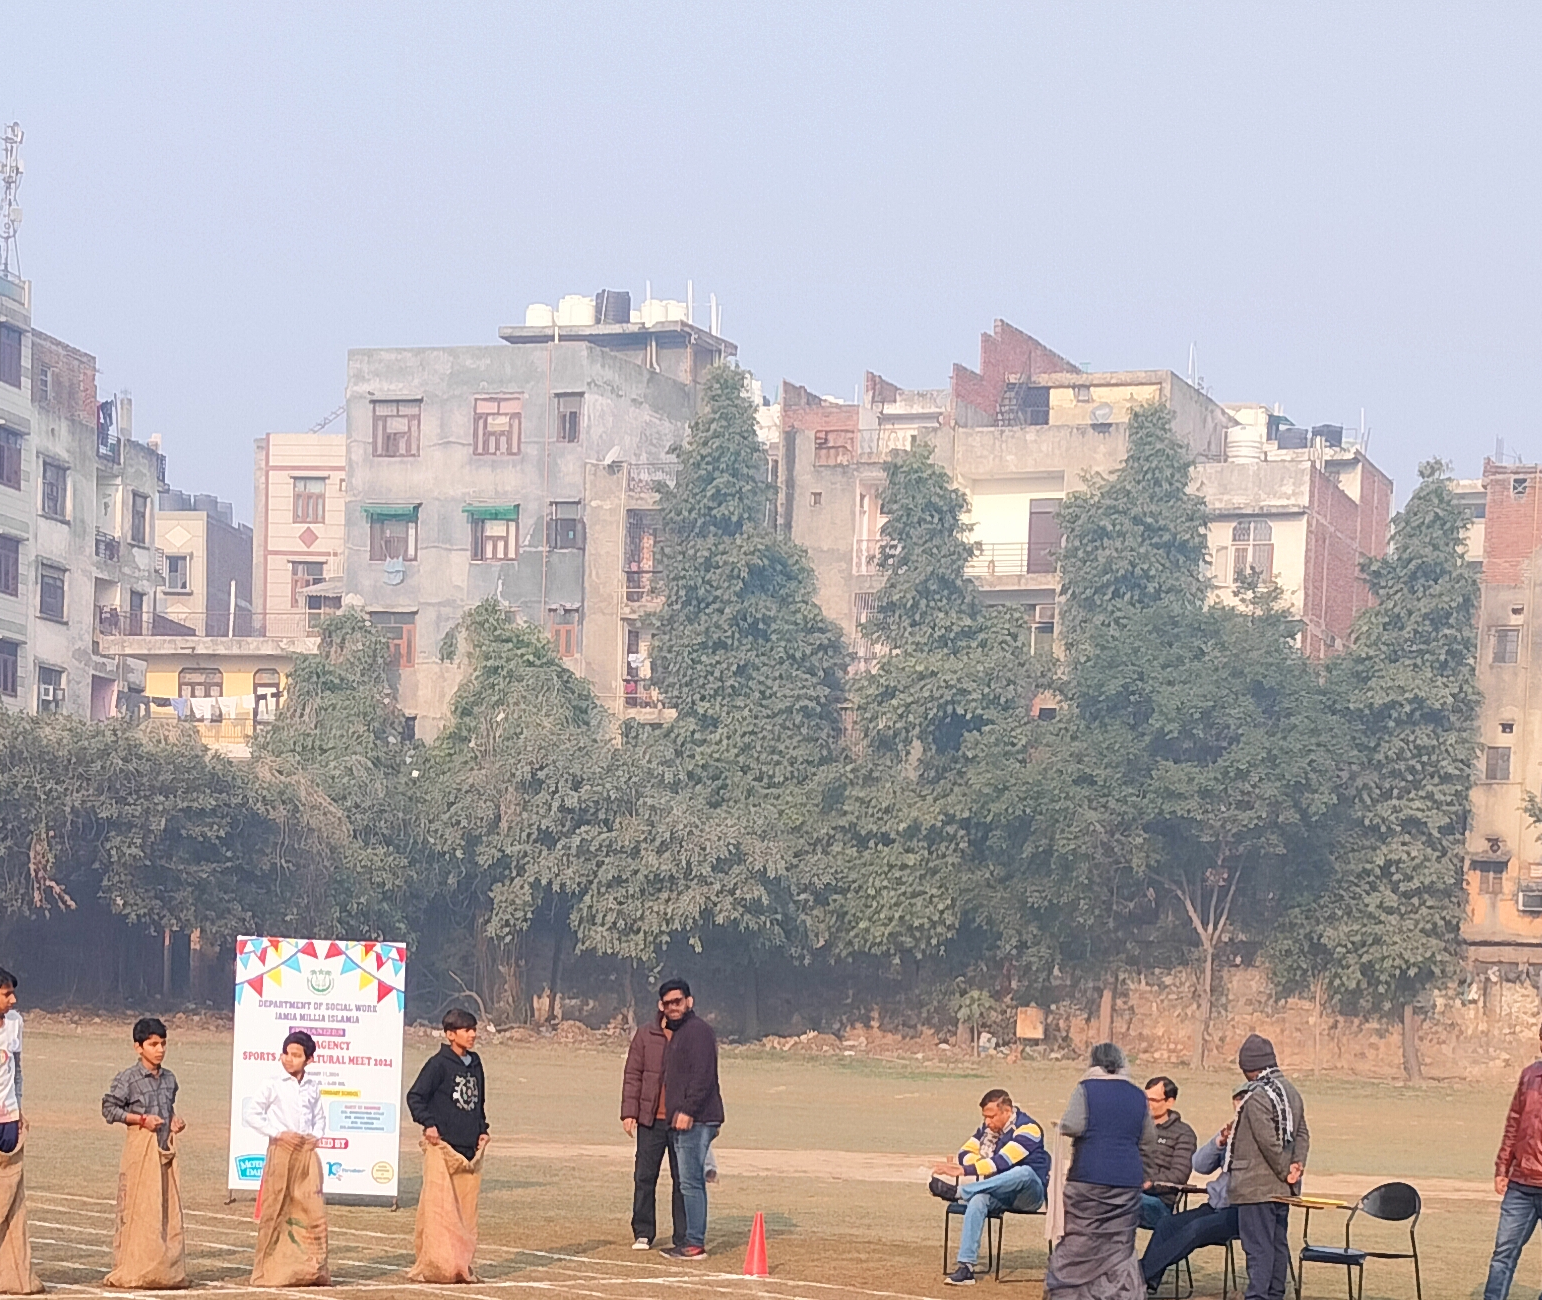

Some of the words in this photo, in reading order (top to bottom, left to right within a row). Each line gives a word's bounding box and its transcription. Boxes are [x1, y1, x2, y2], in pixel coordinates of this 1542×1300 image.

[258, 1000, 311, 1010] DEPARTMENT
[314, 1002, 323, 1010] OF
[325, 1003, 353, 1012] SOCIAL
[355, 1004, 378, 1013] WORK
[275, 1012, 297, 1021] JAMIA
[299, 1013, 325, 1022] MILLIA
[328, 1015, 359, 1024] ISLAMIA
[316, 1041, 351, 1051] AGENCY
[243, 1051, 277, 1061] SPORTS
[312, 1054, 346, 1065] LTURAL
[348, 1056, 372, 1066] MEET
[374, 1058, 393, 1068] 2024
[246, 1168, 261, 1176] DAI
